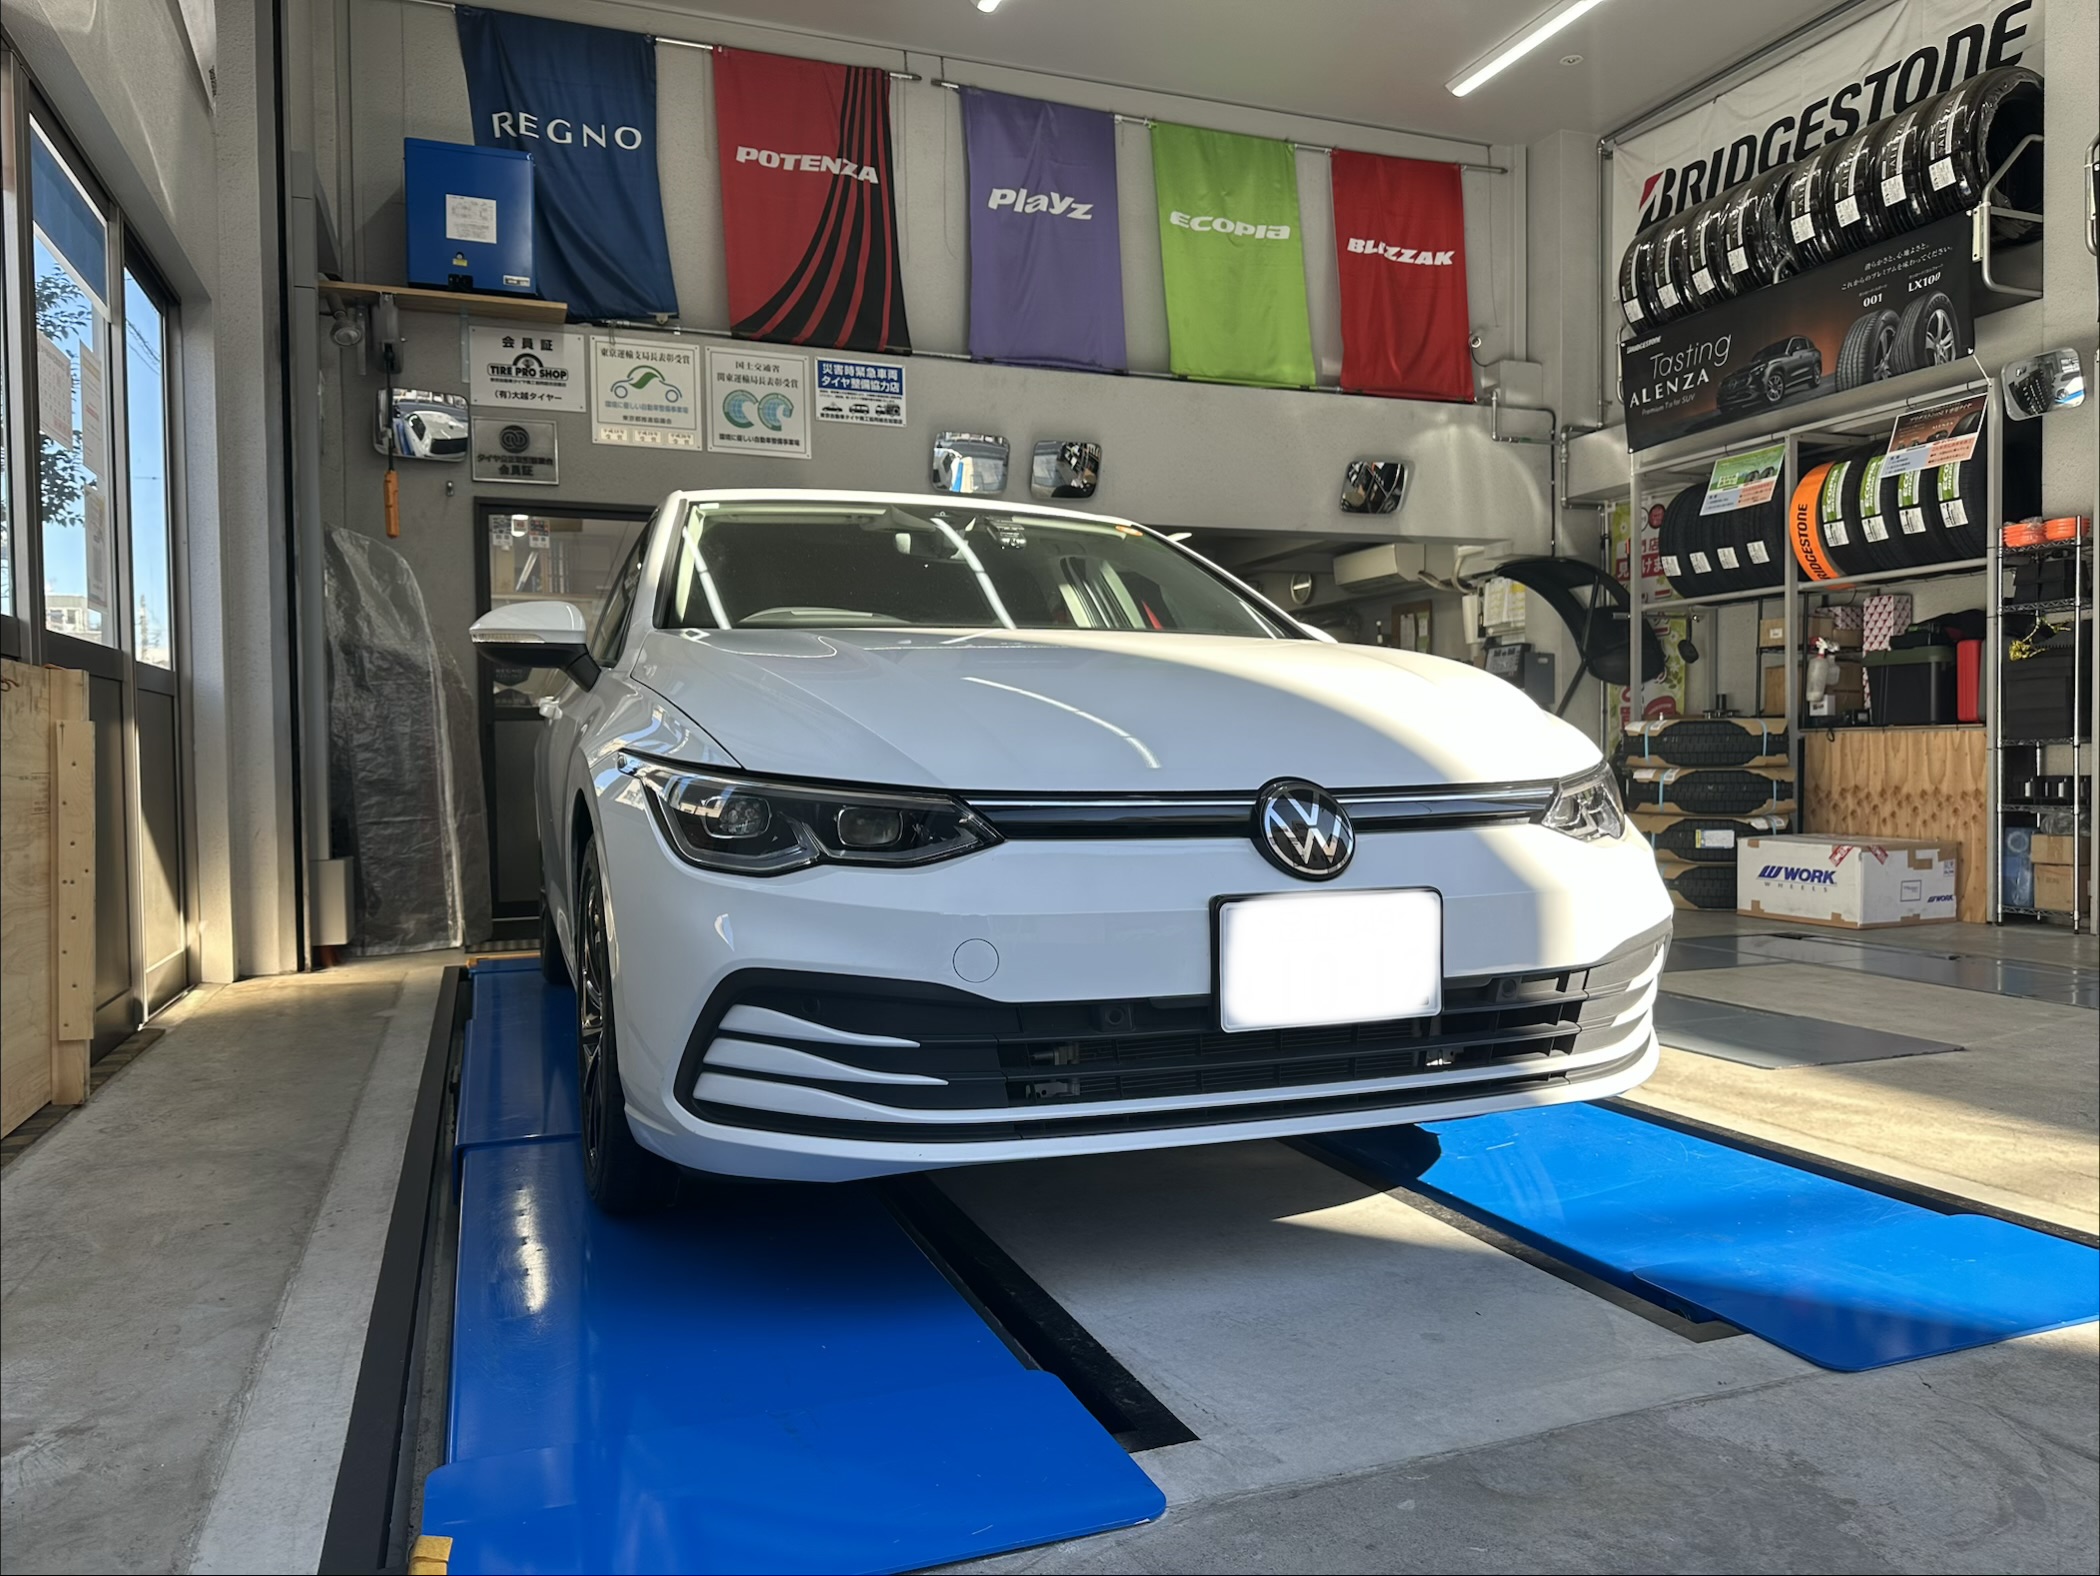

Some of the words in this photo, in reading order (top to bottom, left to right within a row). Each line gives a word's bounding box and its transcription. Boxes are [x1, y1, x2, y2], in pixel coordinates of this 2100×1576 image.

[1636, 0, 2032, 235] BRIDGESTONE
[491, 111, 643, 151] REGNO
[735, 145, 880, 184] POTENZA
[1347, 237, 1455, 266] BLIZZAK
[1863, 293, 1883, 308] 001
[502, 335, 553, 351] 会員証
[1650, 334, 1732, 380] Tasting
[490, 365, 513, 375] TIRE
[515, 366, 536, 377] PRO
[539, 369, 567, 379] SHOP
[735, 361, 780, 373] 国土交通省
[822, 363, 898, 380] 災害時緊急車両
[821, 375, 900, 393] タイヤ整備協力店
[1629, 368, 1709, 408] ALENZA
[1681, 393, 1696, 405] SUV
[1796, 503, 1830, 580] RIDGESTONE
[1784, 866, 1838, 885] WORK
